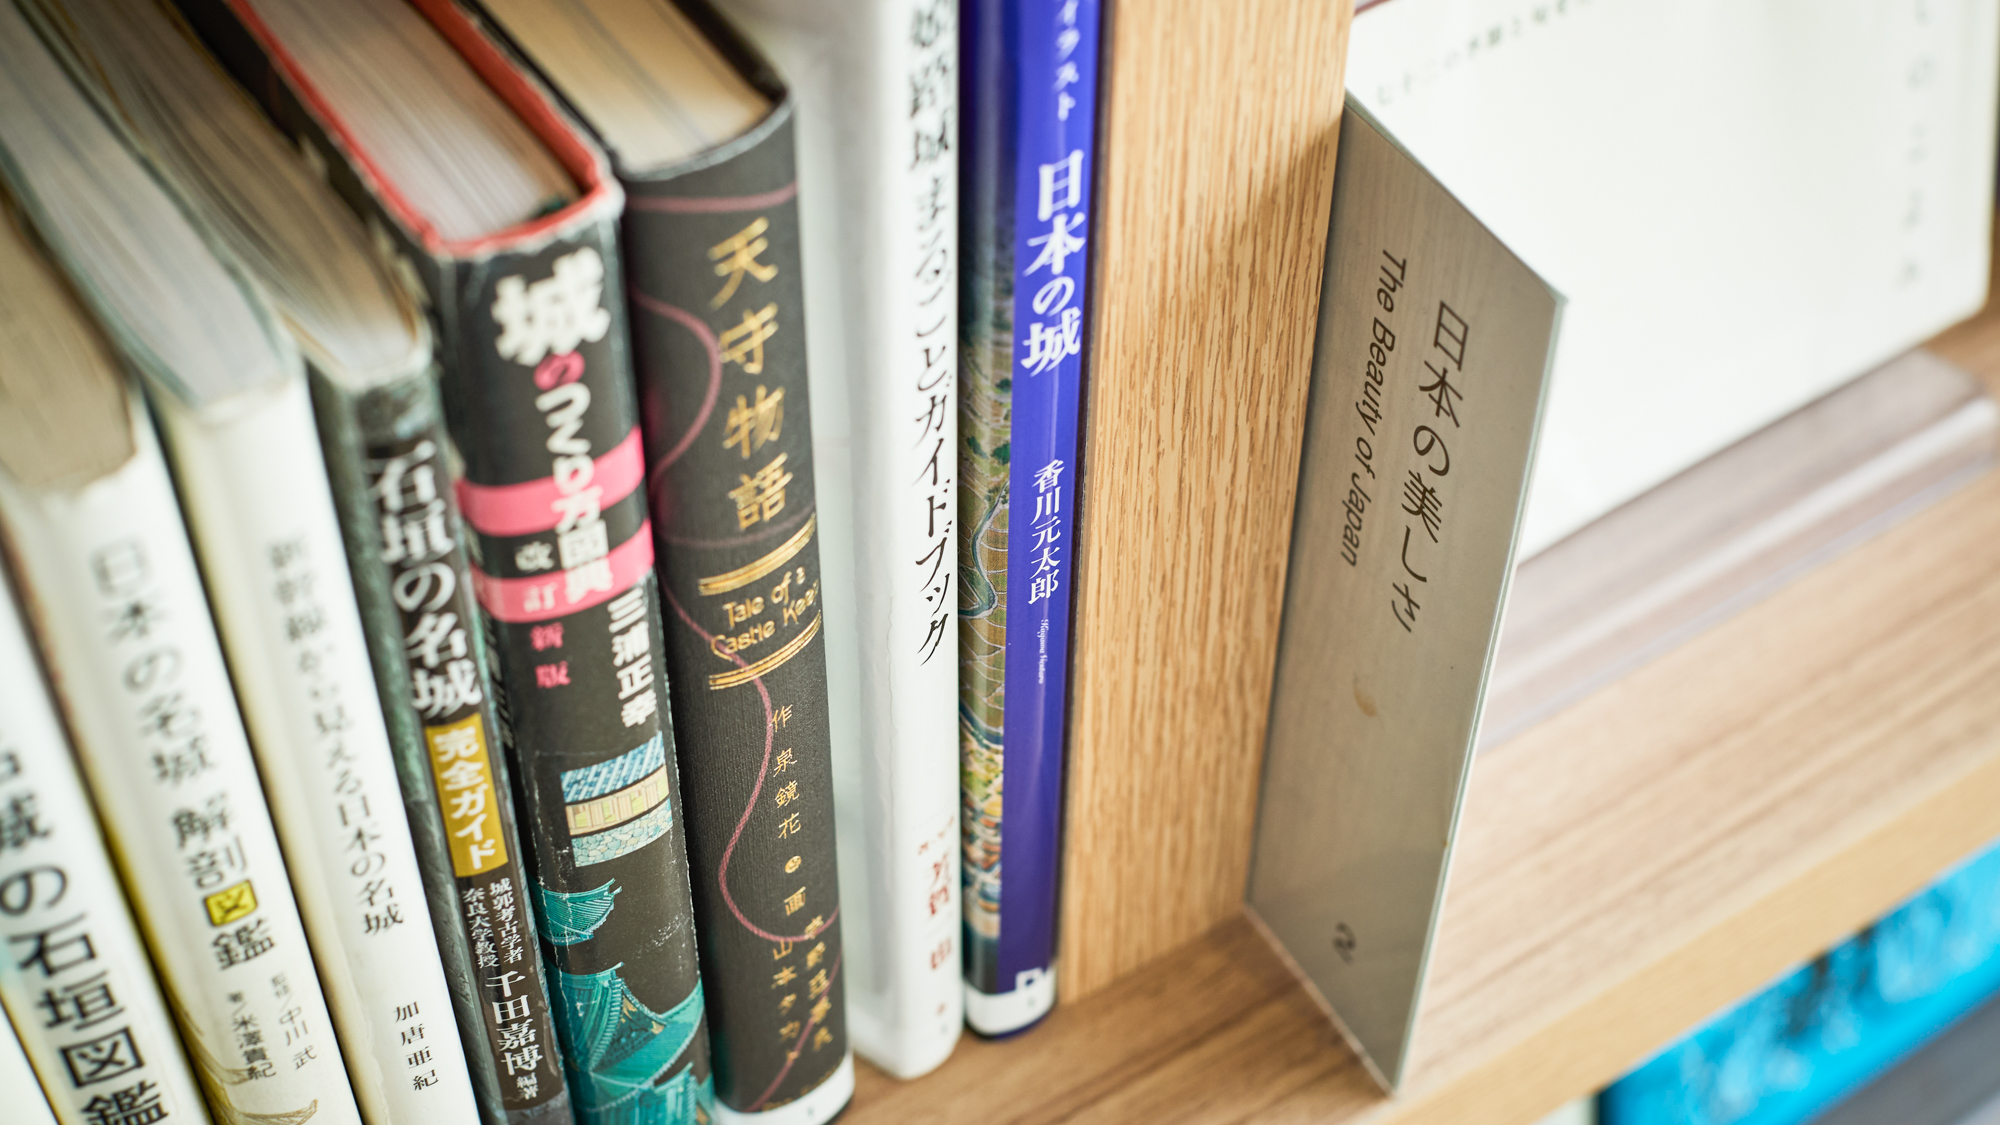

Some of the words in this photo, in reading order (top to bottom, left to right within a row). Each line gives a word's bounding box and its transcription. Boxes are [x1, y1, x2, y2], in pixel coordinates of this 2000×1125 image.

[1021, 149, 1086, 378] 日本の城
[1376, 249, 1407, 313] The
[706, 216, 792, 531] 天守物語
[1355, 316, 1397, 437] Beauty
[1353, 437, 1376, 480] of
[1391, 300, 1469, 633] 日本の美しさ
[1028, 459, 1065, 605] 香川元太郎
[1340, 472, 1372, 567] Japan
[711, 620, 776, 661] Castle
[722, 596, 765, 630] Tale
[771, 571, 792, 605] of
[796, 566, 806, 585] a
[368, 440, 487, 722] 石垣の名城
[434, 727, 496, 871] 完全ガイド
[607, 586, 657, 728] 三浦正幸
[771, 704, 793, 732] 作
[773, 747, 802, 840] 泉鏡花
[462, 886, 500, 969] 奈良大学教授
[489, 877, 524, 964] 城郭考古学者
[784, 886, 806, 916] 画
[393, 1000, 440, 1092] 加唐亜紀
[485, 970, 543, 1076] 千田嘉博
